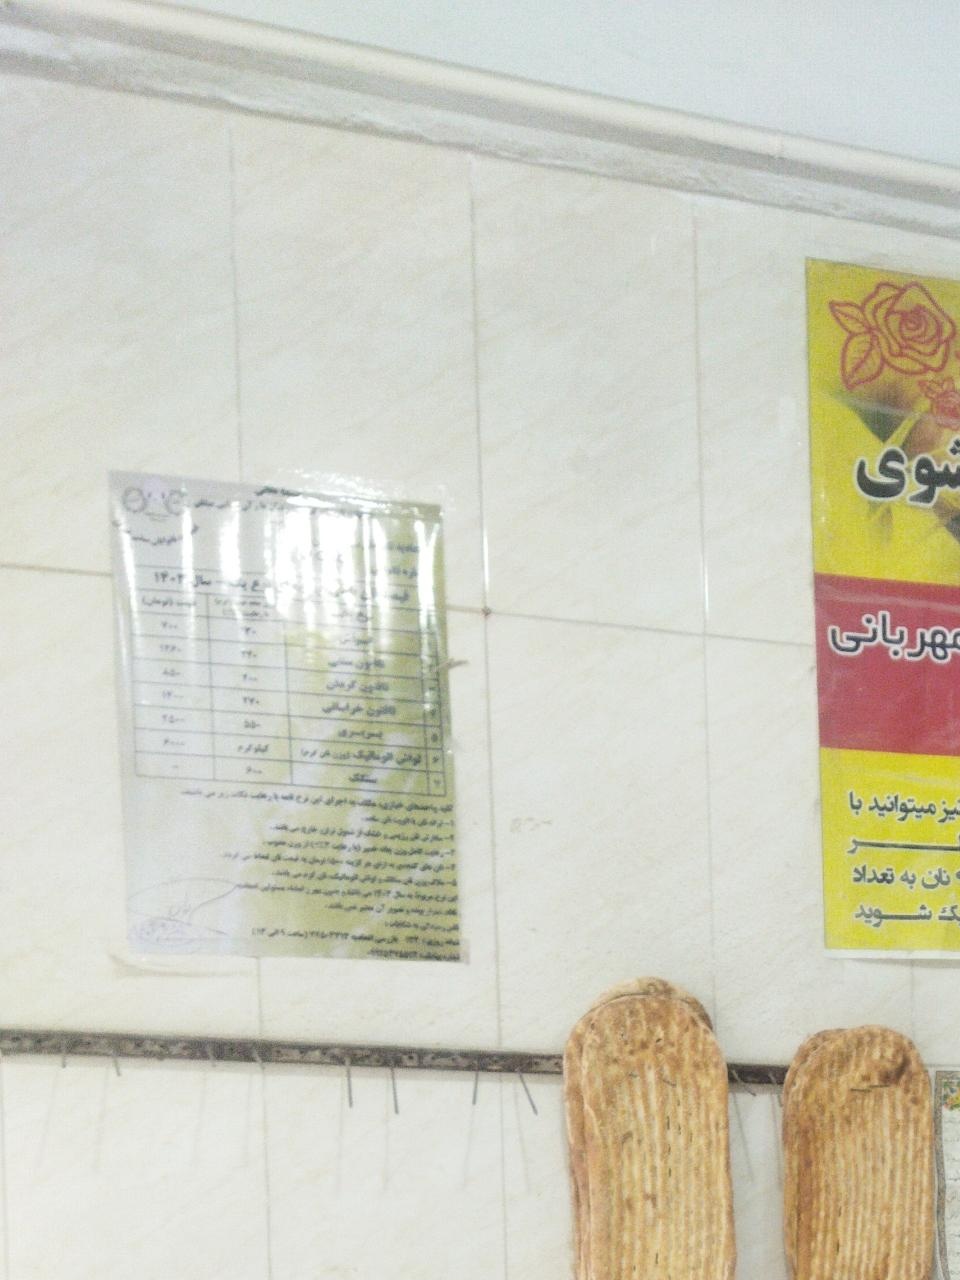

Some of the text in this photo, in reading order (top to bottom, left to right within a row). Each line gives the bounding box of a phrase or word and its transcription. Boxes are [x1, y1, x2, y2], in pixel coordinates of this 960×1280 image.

[848, 791, 864, 815] با
[868, 793, 937, 822] میتوانید
[851, 863, 896, 886] تعداد
[899, 868, 917, 890] به
[921, 866, 951, 891] نان
[854, 901, 933, 928] شوید
